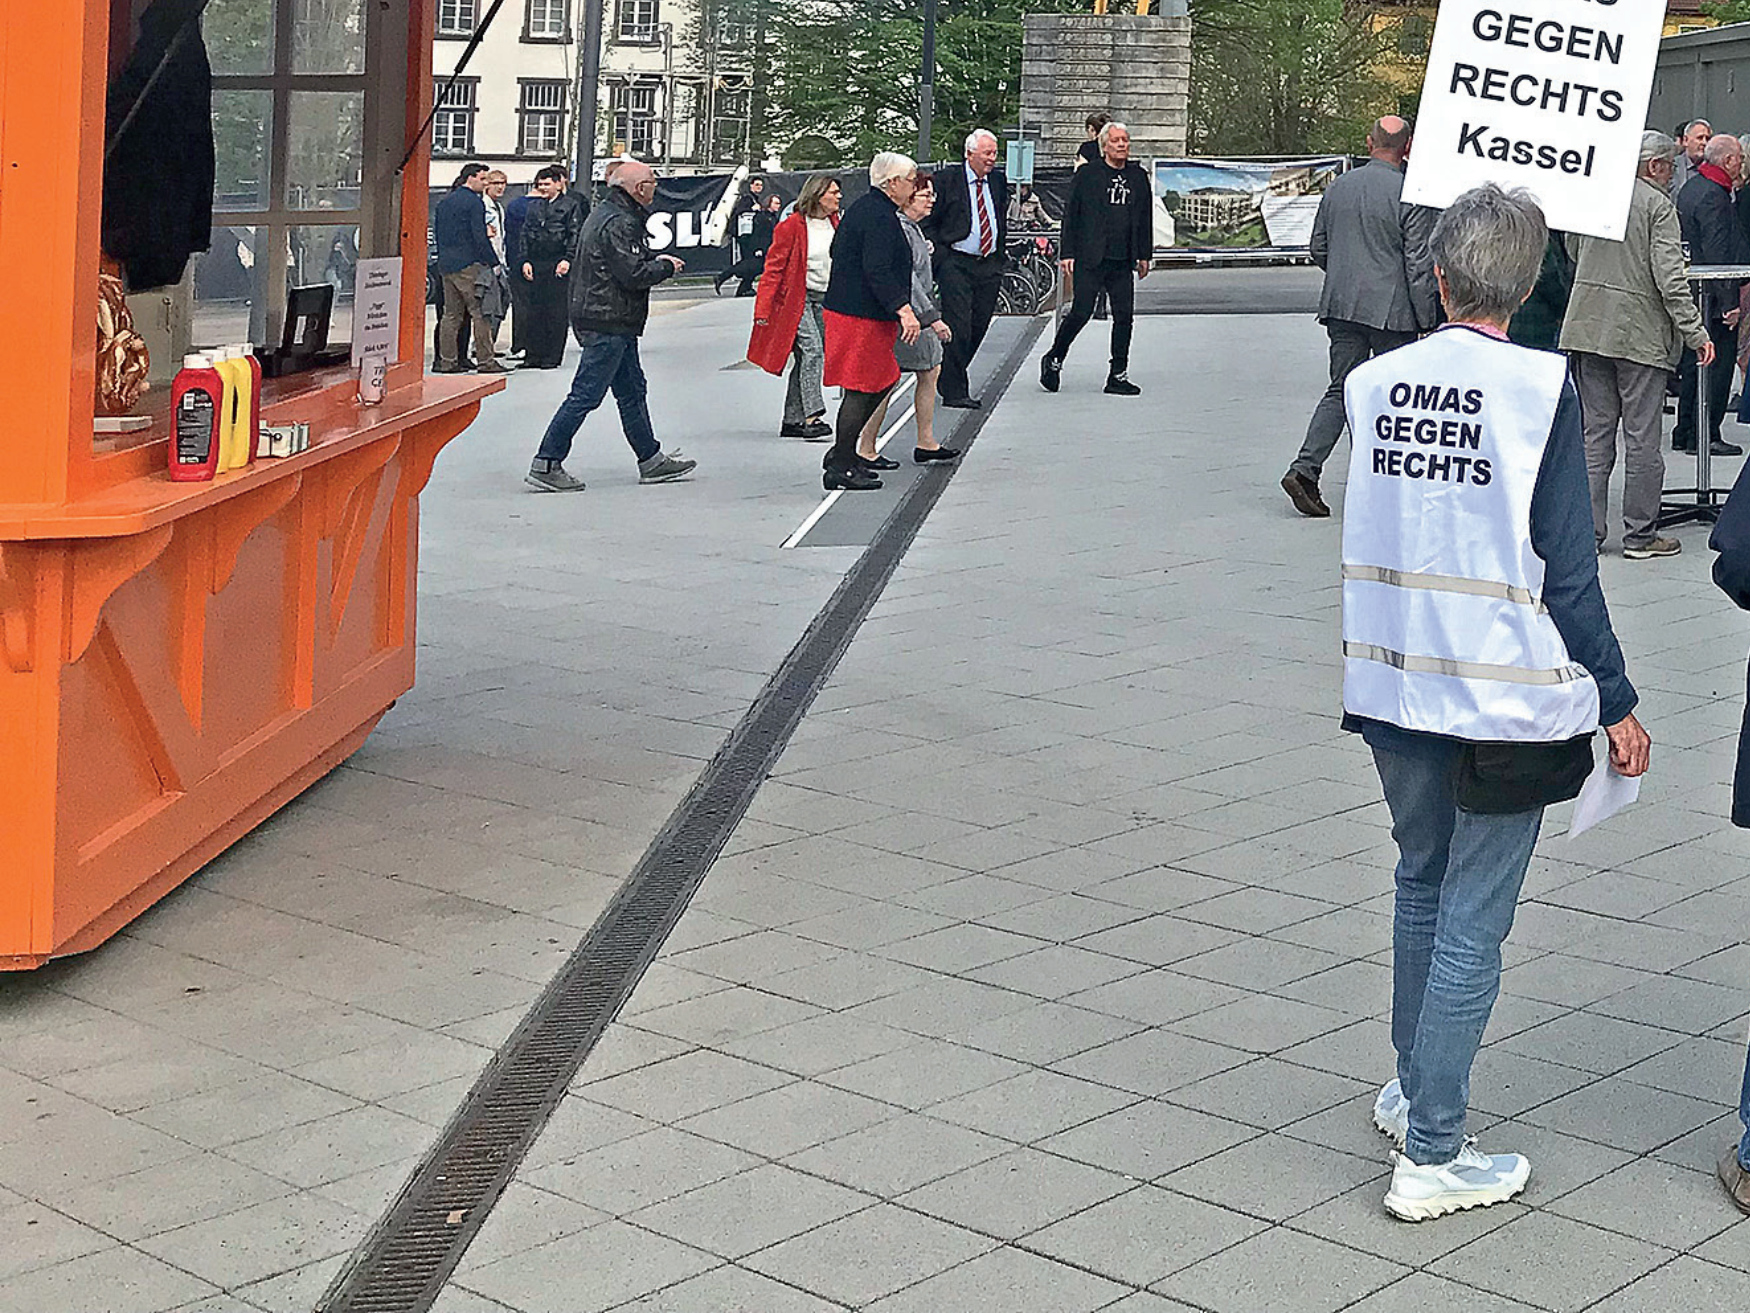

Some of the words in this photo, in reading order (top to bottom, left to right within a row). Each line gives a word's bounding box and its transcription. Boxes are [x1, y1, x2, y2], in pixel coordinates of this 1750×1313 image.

[1472, 9, 1623, 64] GEGEN
[1449, 63, 1623, 122] RECHTS
[1457, 123, 1595, 177] Kassel
[1390, 382, 1483, 415] OMAS
[1376, 416, 1482, 450] GEGEN
[1373, 448, 1492, 486] RECHTS
